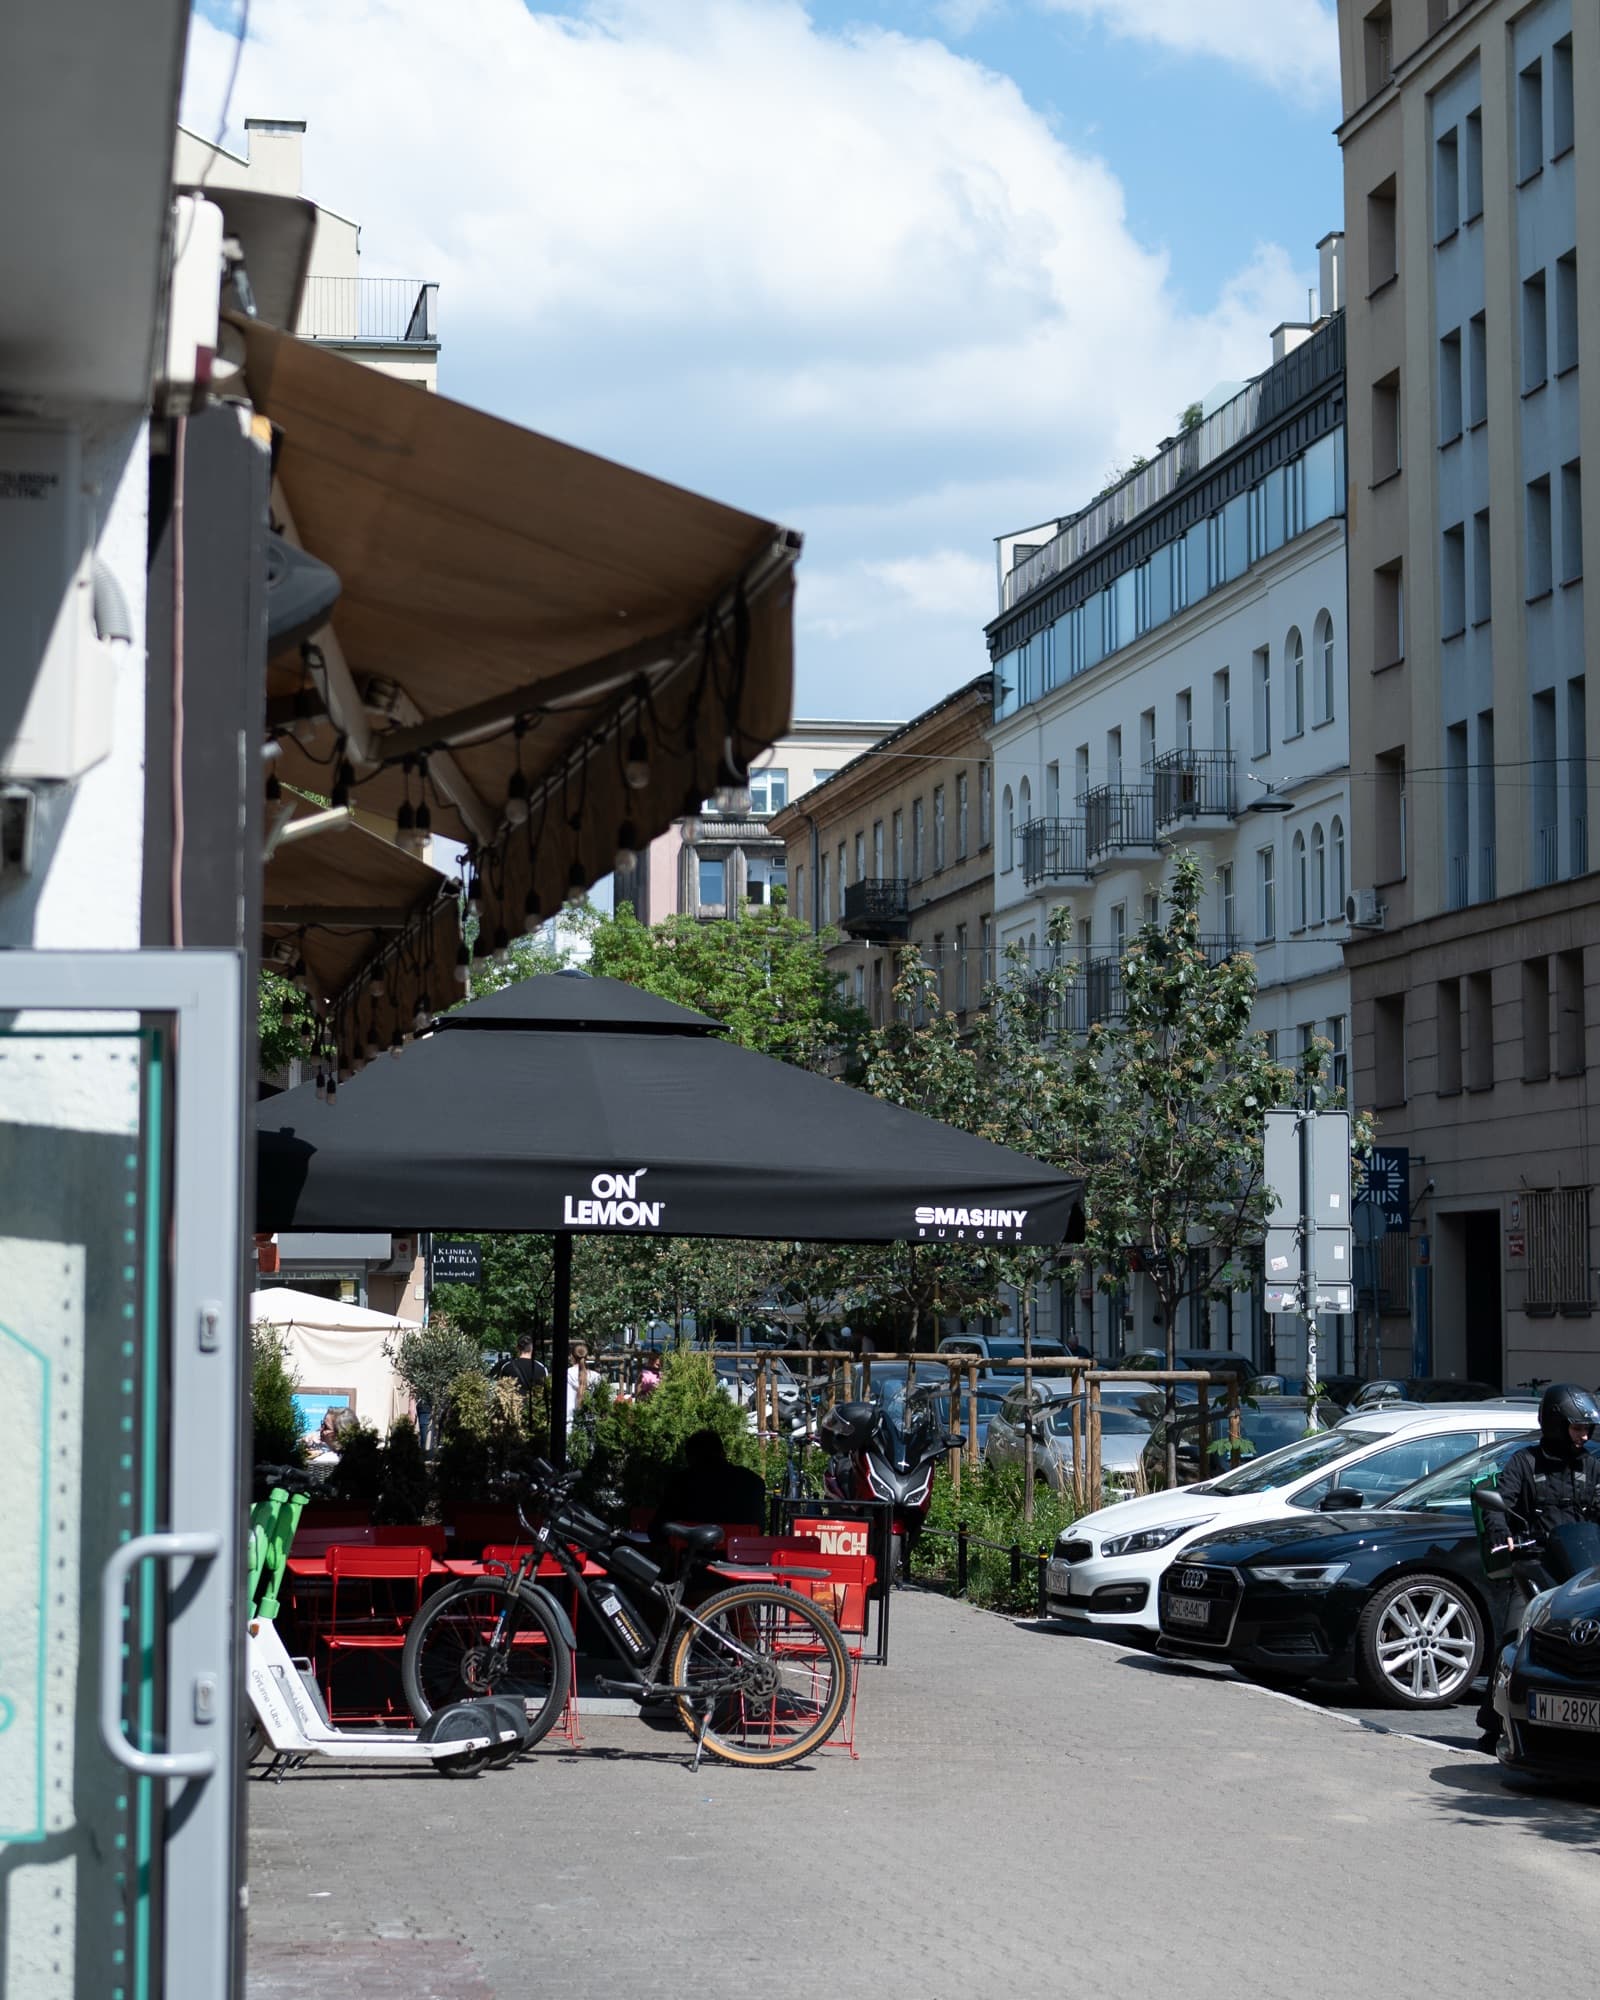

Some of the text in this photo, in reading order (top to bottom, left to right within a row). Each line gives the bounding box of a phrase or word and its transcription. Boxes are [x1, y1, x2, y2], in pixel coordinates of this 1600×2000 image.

[591, 1173, 637, 1199] ON
[915, 1206, 1028, 1227] SMASHNY
[919, 1228, 1023, 1241] BURGER
[433, 1255, 478, 1264] LA PERLA
[794, 1530, 868, 1556] NCH
[1539, 1695, 1600, 1727] WI 289K
